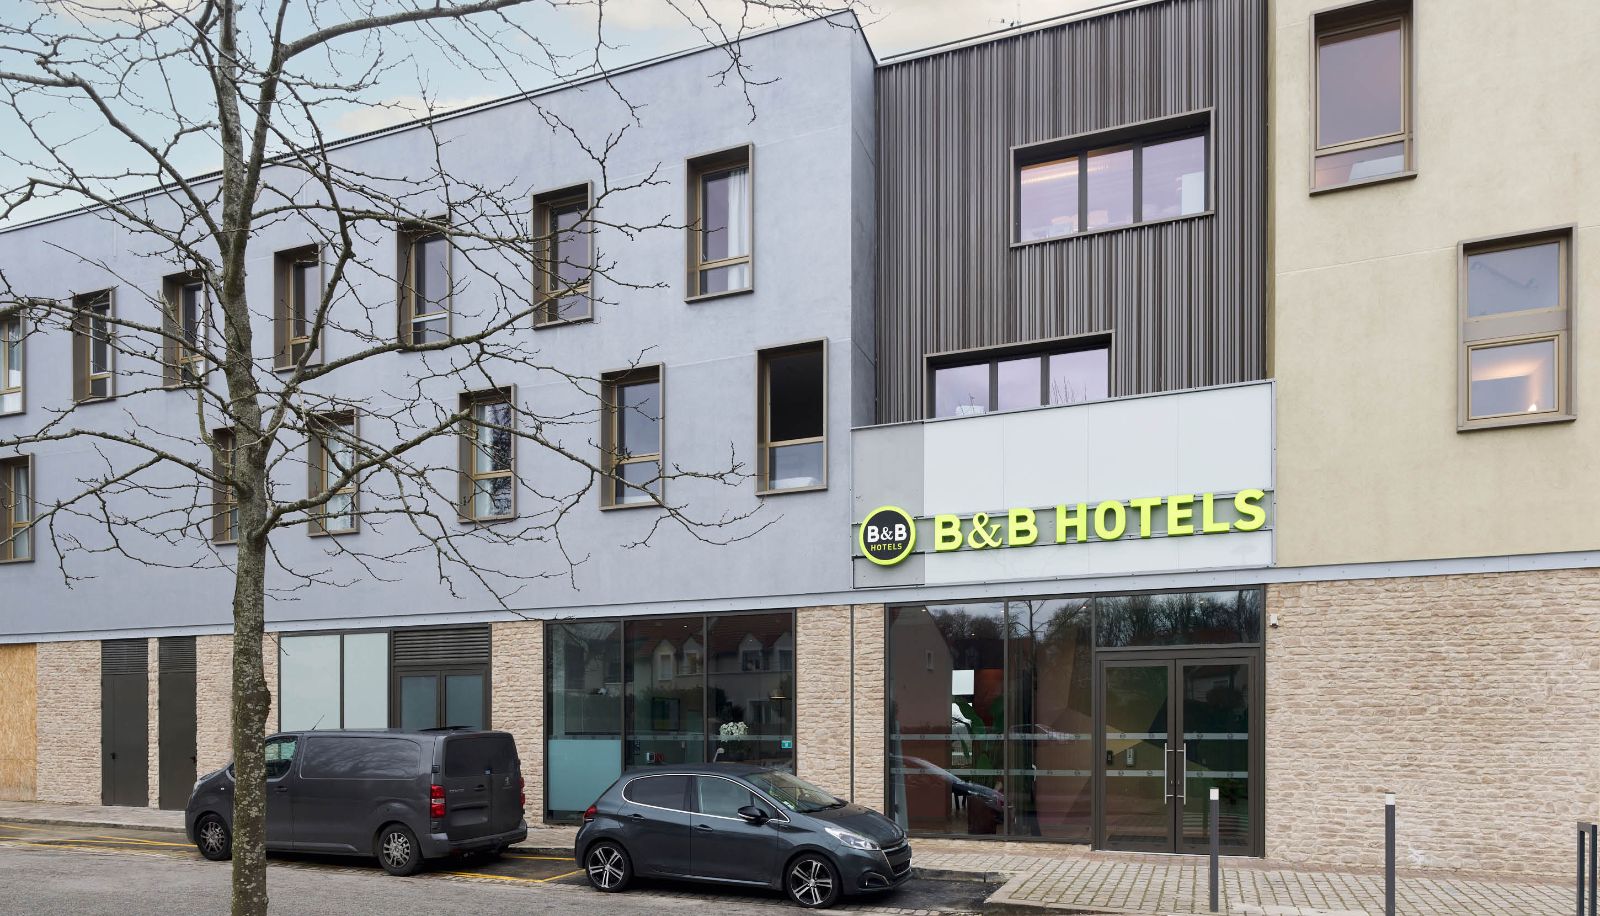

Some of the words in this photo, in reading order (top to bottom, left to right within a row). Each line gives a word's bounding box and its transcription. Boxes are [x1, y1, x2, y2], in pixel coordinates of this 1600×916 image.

[934, 507, 1039, 551] B&B
[1056, 488, 1267, 544] HOTELS
[867, 523, 907, 542] B&B
[870, 543, 902, 551] HOTELS
